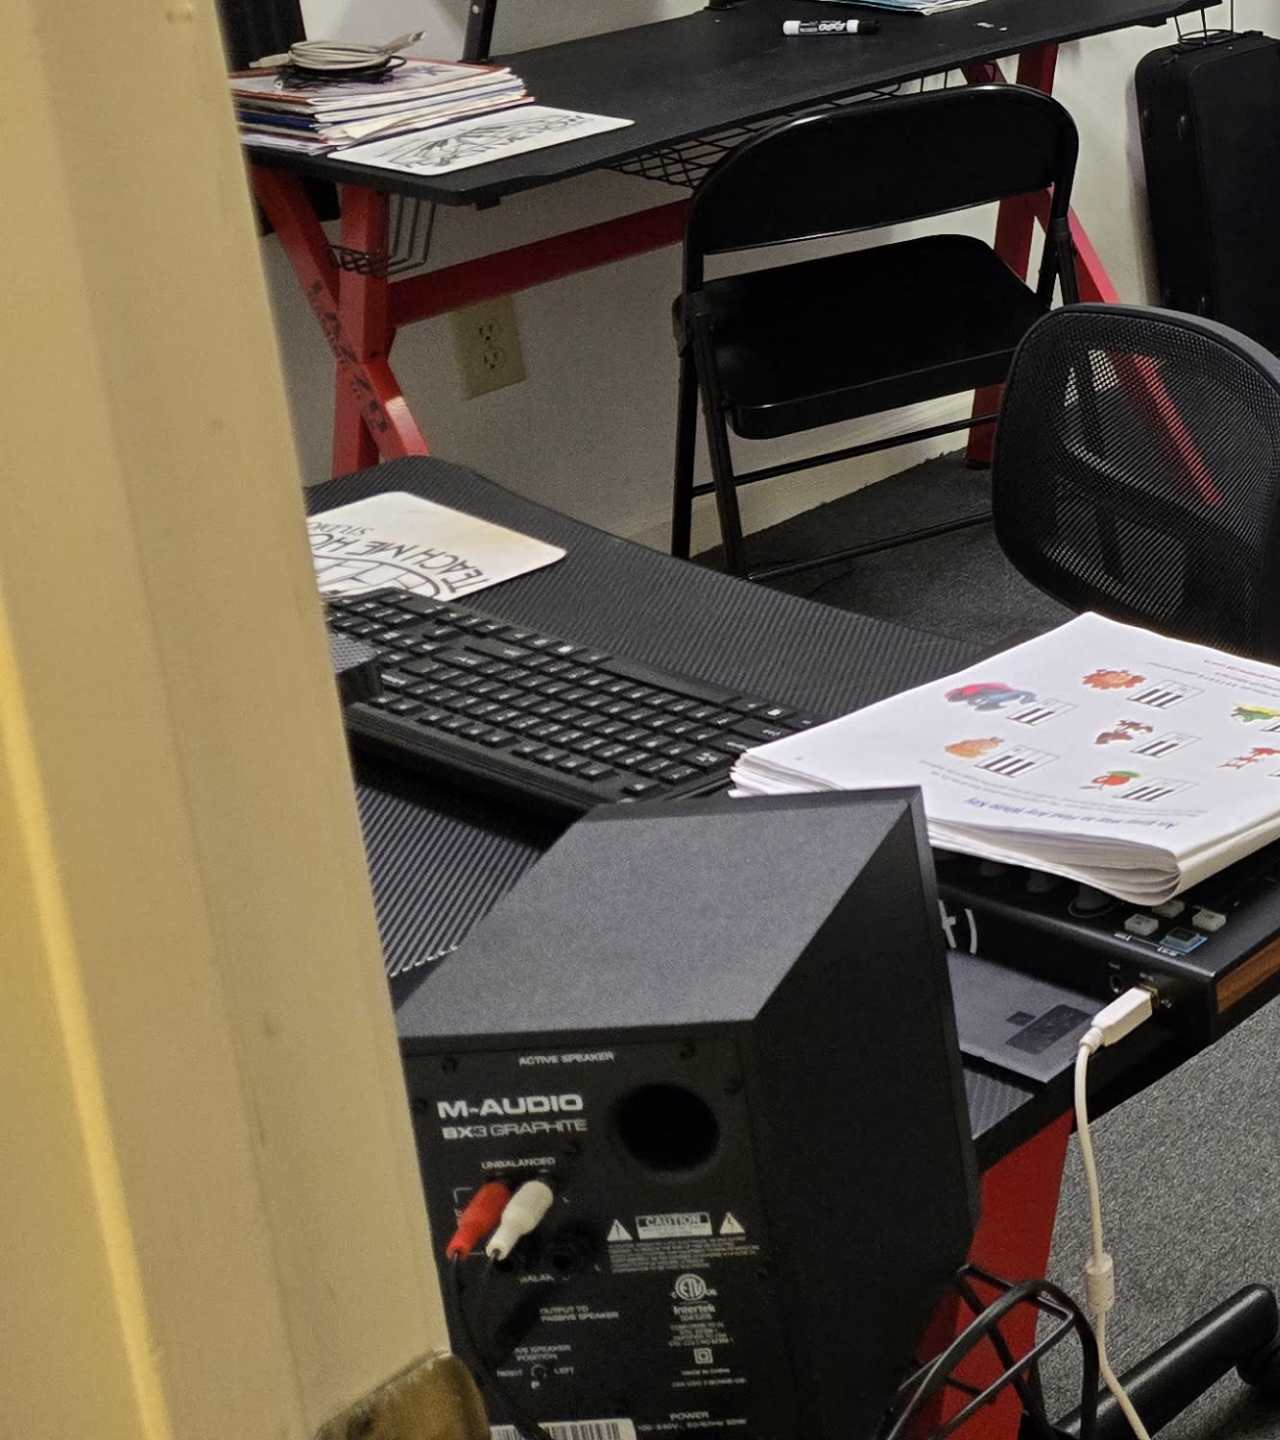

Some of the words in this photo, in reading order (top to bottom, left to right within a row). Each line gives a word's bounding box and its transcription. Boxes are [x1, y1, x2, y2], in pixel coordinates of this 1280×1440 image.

[309, 533, 362, 552] HO
[344, 541, 420, 558] ME
[400, 548, 489, 593] TEACH
[519, 1055, 558, 1066] ACTIVE
[561, 1051, 615, 1064] SPEAKER
[437, 1093, 584, 1119] M-AUDIO
[441, 1125, 488, 1140] BX3
[490, 1118, 588, 1137] GRAPHITE
[480, 1156, 556, 1170] UNBALANCED
[645, 1213, 702, 1228] CAUTION
[578, 1311, 619, 1321] SPEAKER
[670, 1411, 709, 1421] POWER
